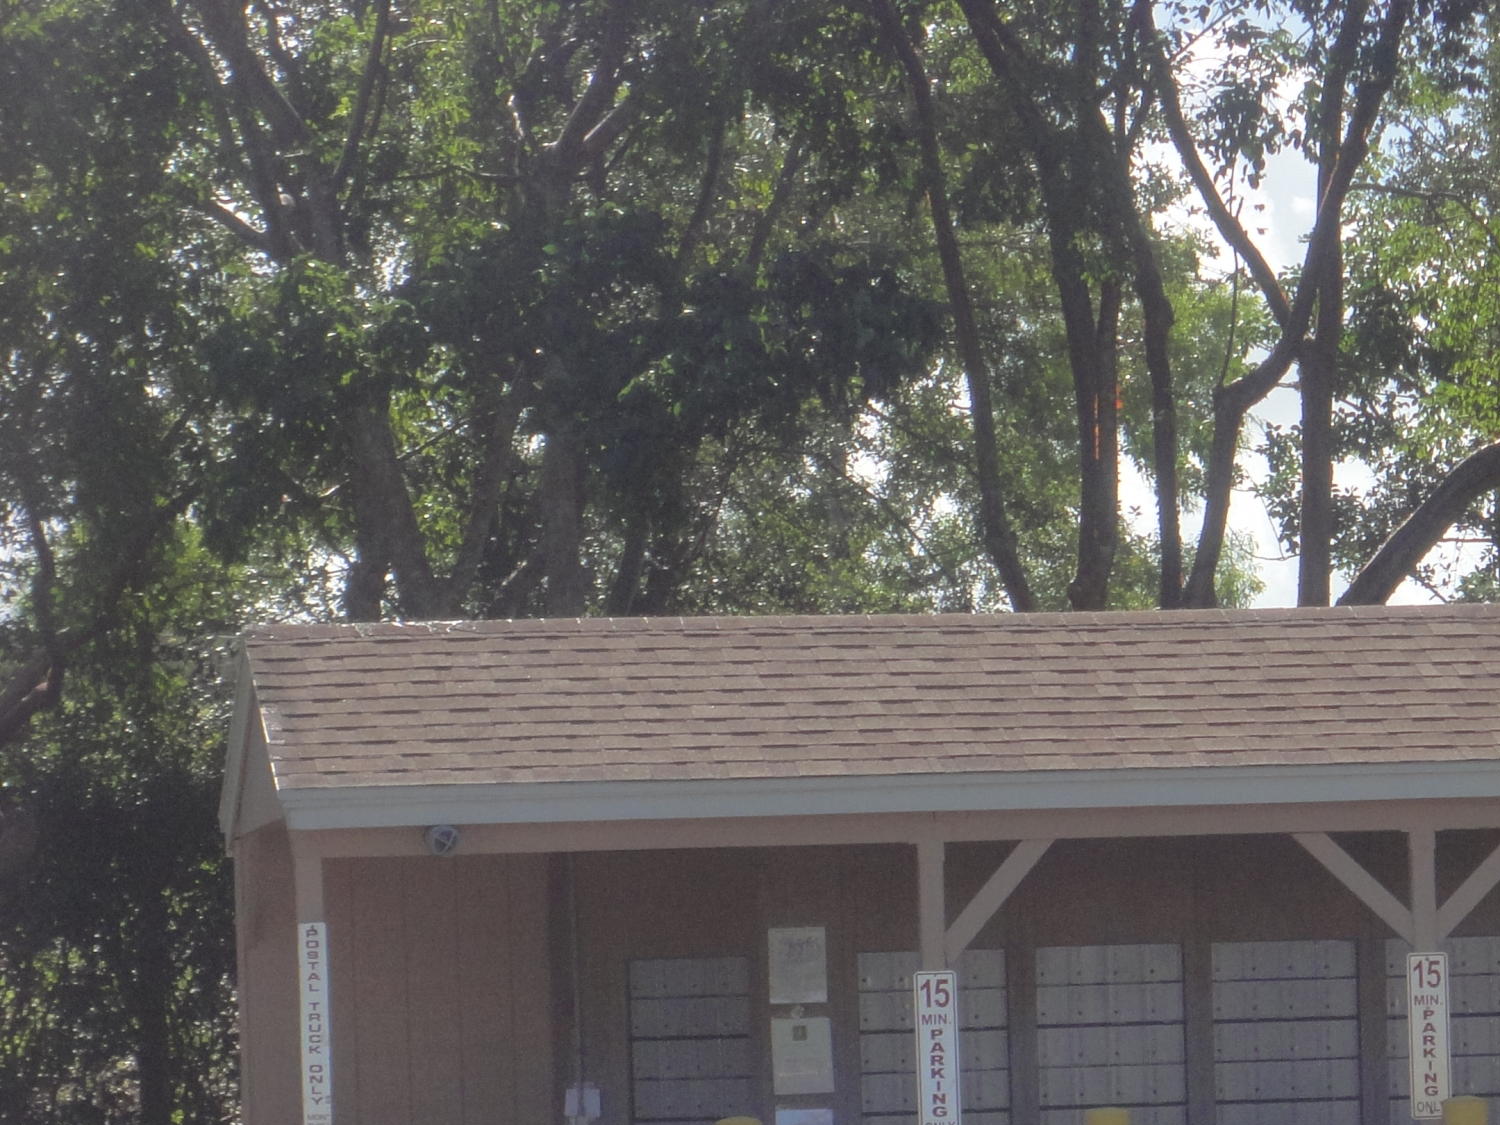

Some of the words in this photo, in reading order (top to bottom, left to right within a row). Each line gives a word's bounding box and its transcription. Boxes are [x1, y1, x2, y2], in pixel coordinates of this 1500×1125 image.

[305, 929, 321, 992] POSTAL
[1413, 960, 1442, 989] 15
[920, 979, 950, 1009] 15
[1413, 994, 1443, 1006] MIN.
[307, 1002, 322, 1055] TRUCK
[921, 1014, 952, 1026] MIN.
[1422, 1009, 1439, 1097] PARKING
[308, 1064, 323, 1106] ONLY
[930, 1029, 948, 1118] PARKING
[1416, 1101, 1443, 1114] ONL
